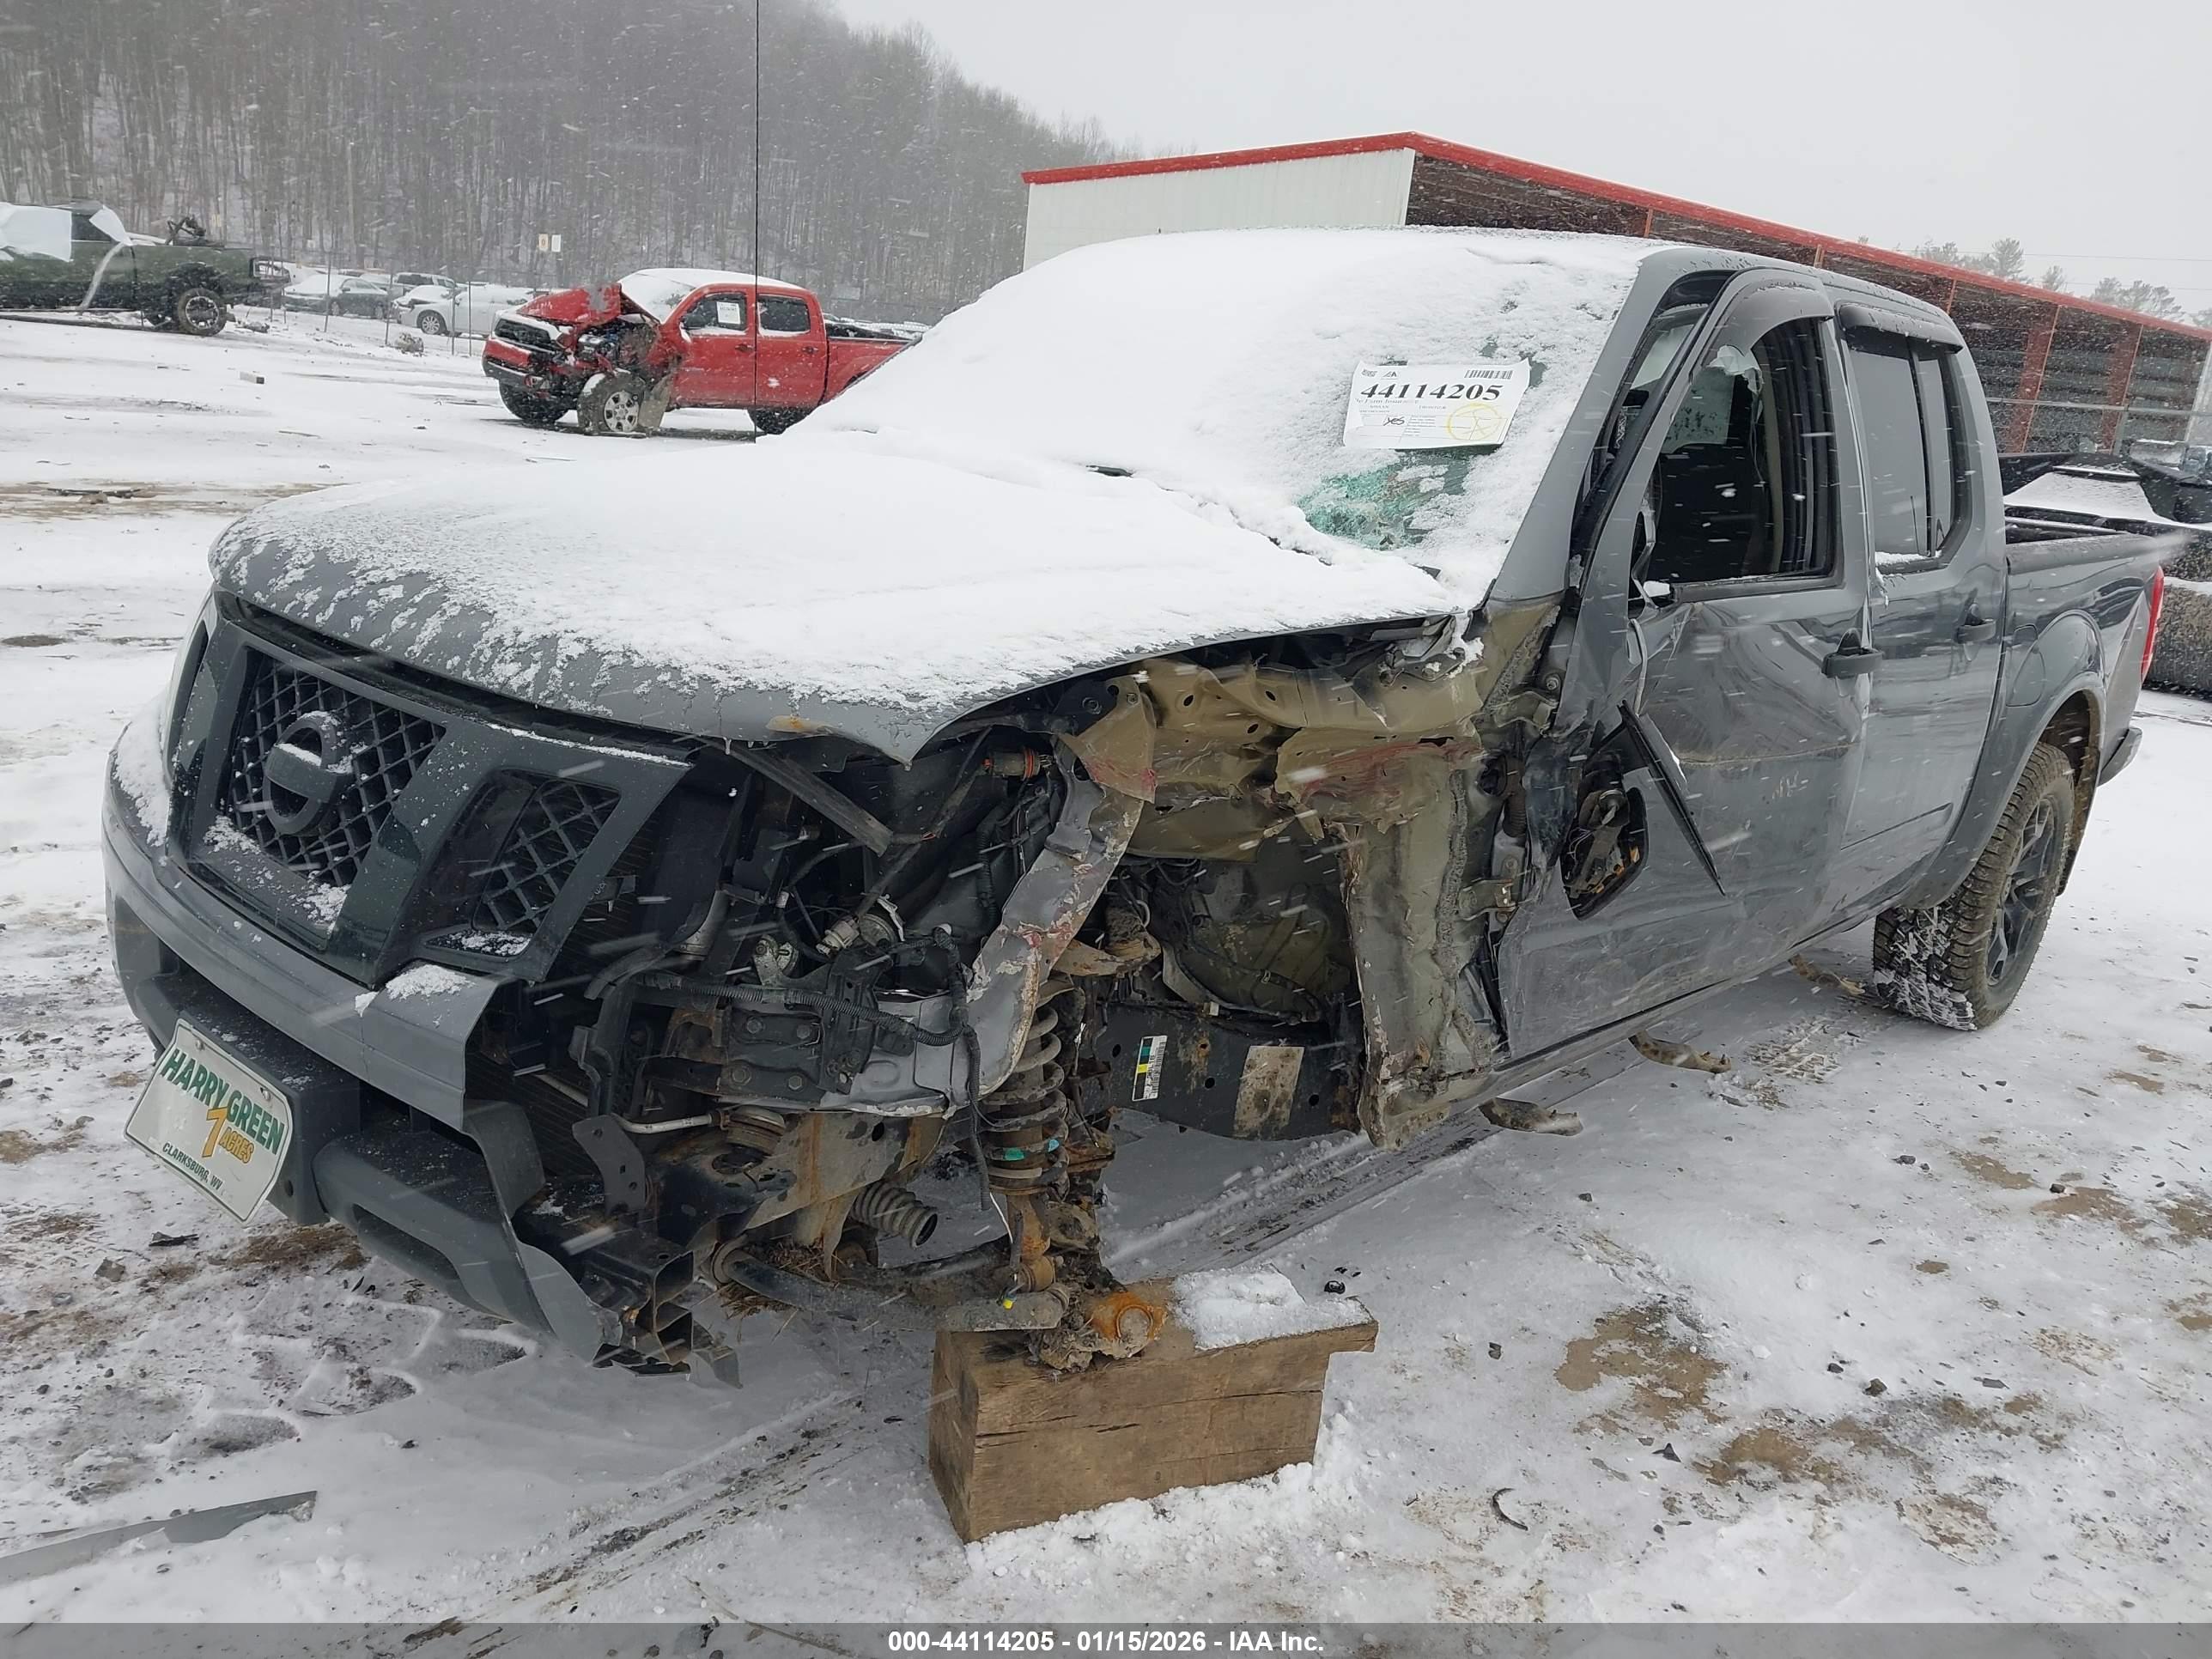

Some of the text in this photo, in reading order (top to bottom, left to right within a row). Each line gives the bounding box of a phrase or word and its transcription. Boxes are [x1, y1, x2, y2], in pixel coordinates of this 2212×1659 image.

[1360, 383, 1504, 401] 44114205
[160, 1048, 285, 1156] HARRY GREEN
[202, 1106, 228, 1158] 7
[219, 1126, 255, 1164] ACRES
[162, 1142, 223, 1191] CLARKSBURG, WV
